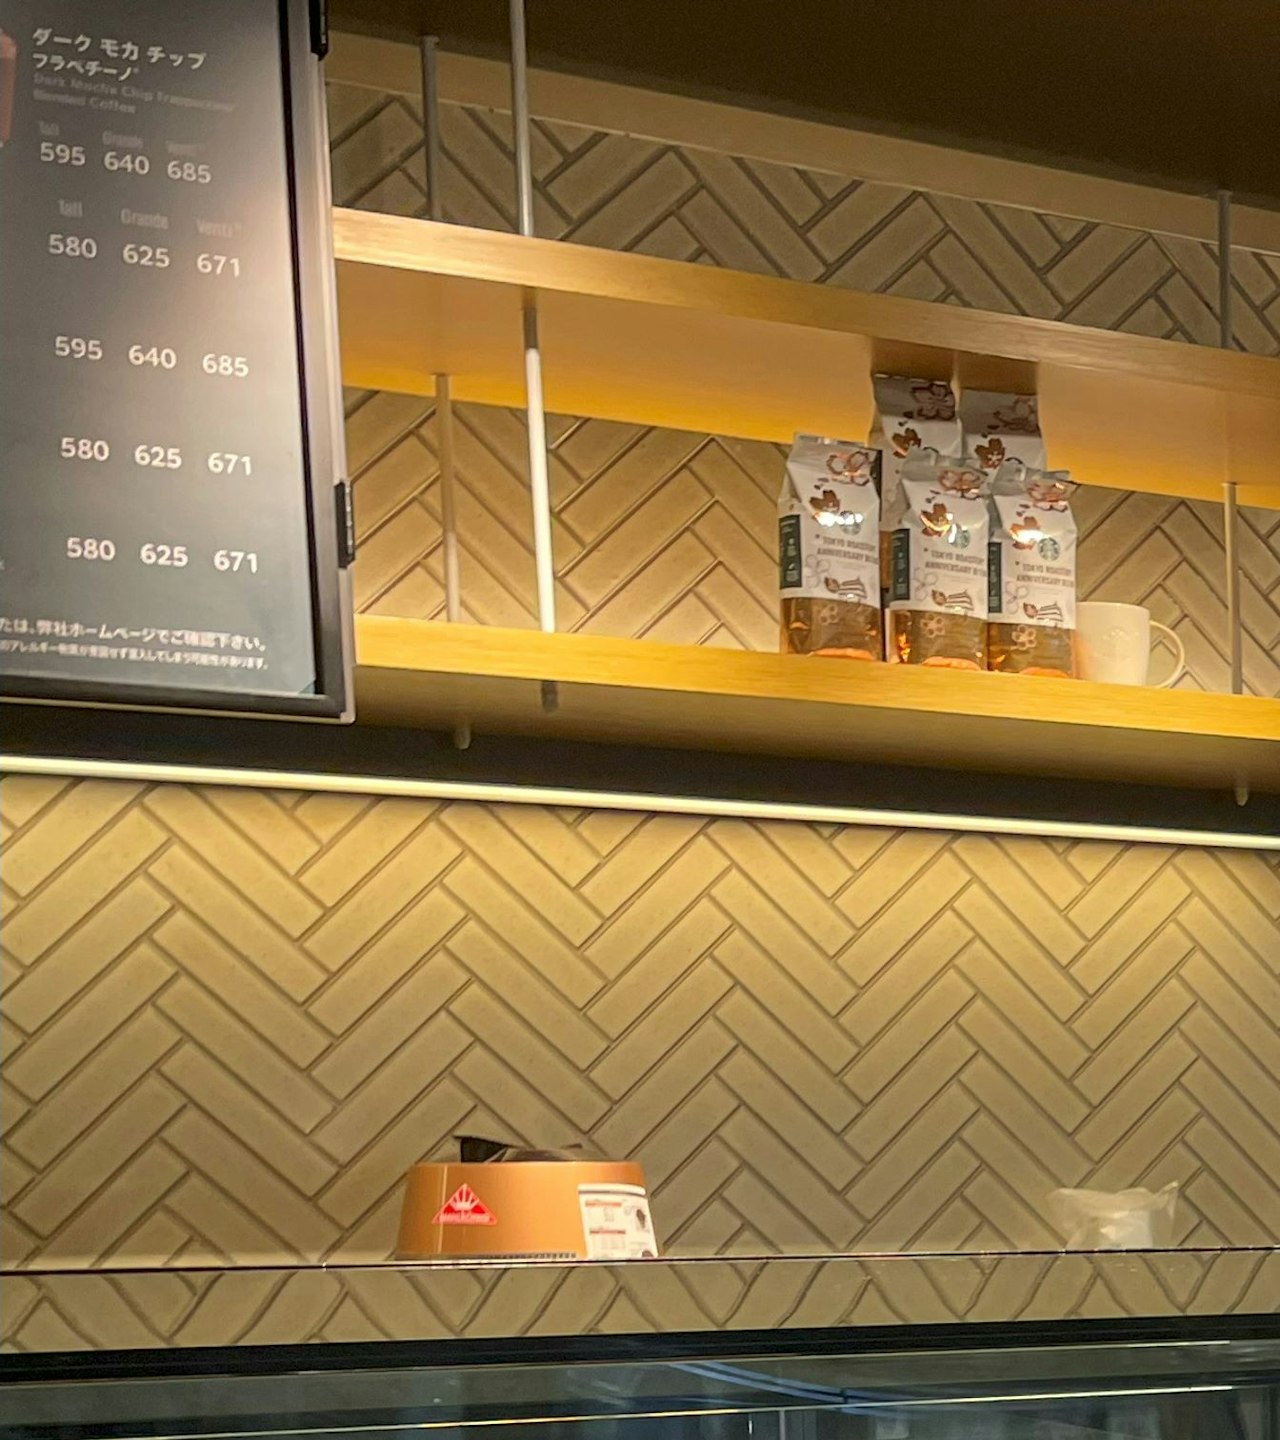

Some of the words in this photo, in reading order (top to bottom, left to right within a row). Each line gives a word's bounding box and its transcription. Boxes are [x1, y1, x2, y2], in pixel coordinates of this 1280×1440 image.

[32, 27, 92, 52] ダーク
[100, 38, 139, 61] モカ
[147, 46, 207, 70] チップ
[40, 141, 86, 166] 595
[104, 151, 150, 175] 640
[167, 160, 212, 184] 685
[58, 200, 83, 218] Tall
[121, 208, 169, 229] Grande
[49, 233, 97, 258] 580
[123, 243, 171, 268] 625
[197, 253, 241, 277] 671
[55, 335, 103, 361] 595
[128, 345, 177, 369] 640
[202, 353, 249, 377] 685
[60, 437, 110, 461] 580
[134, 445, 182, 469] 625
[207, 452, 251, 476] 671
[66, 537, 116, 561] 580
[140, 543, 189, 567] 625
[213, 549, 258, 574] 671
